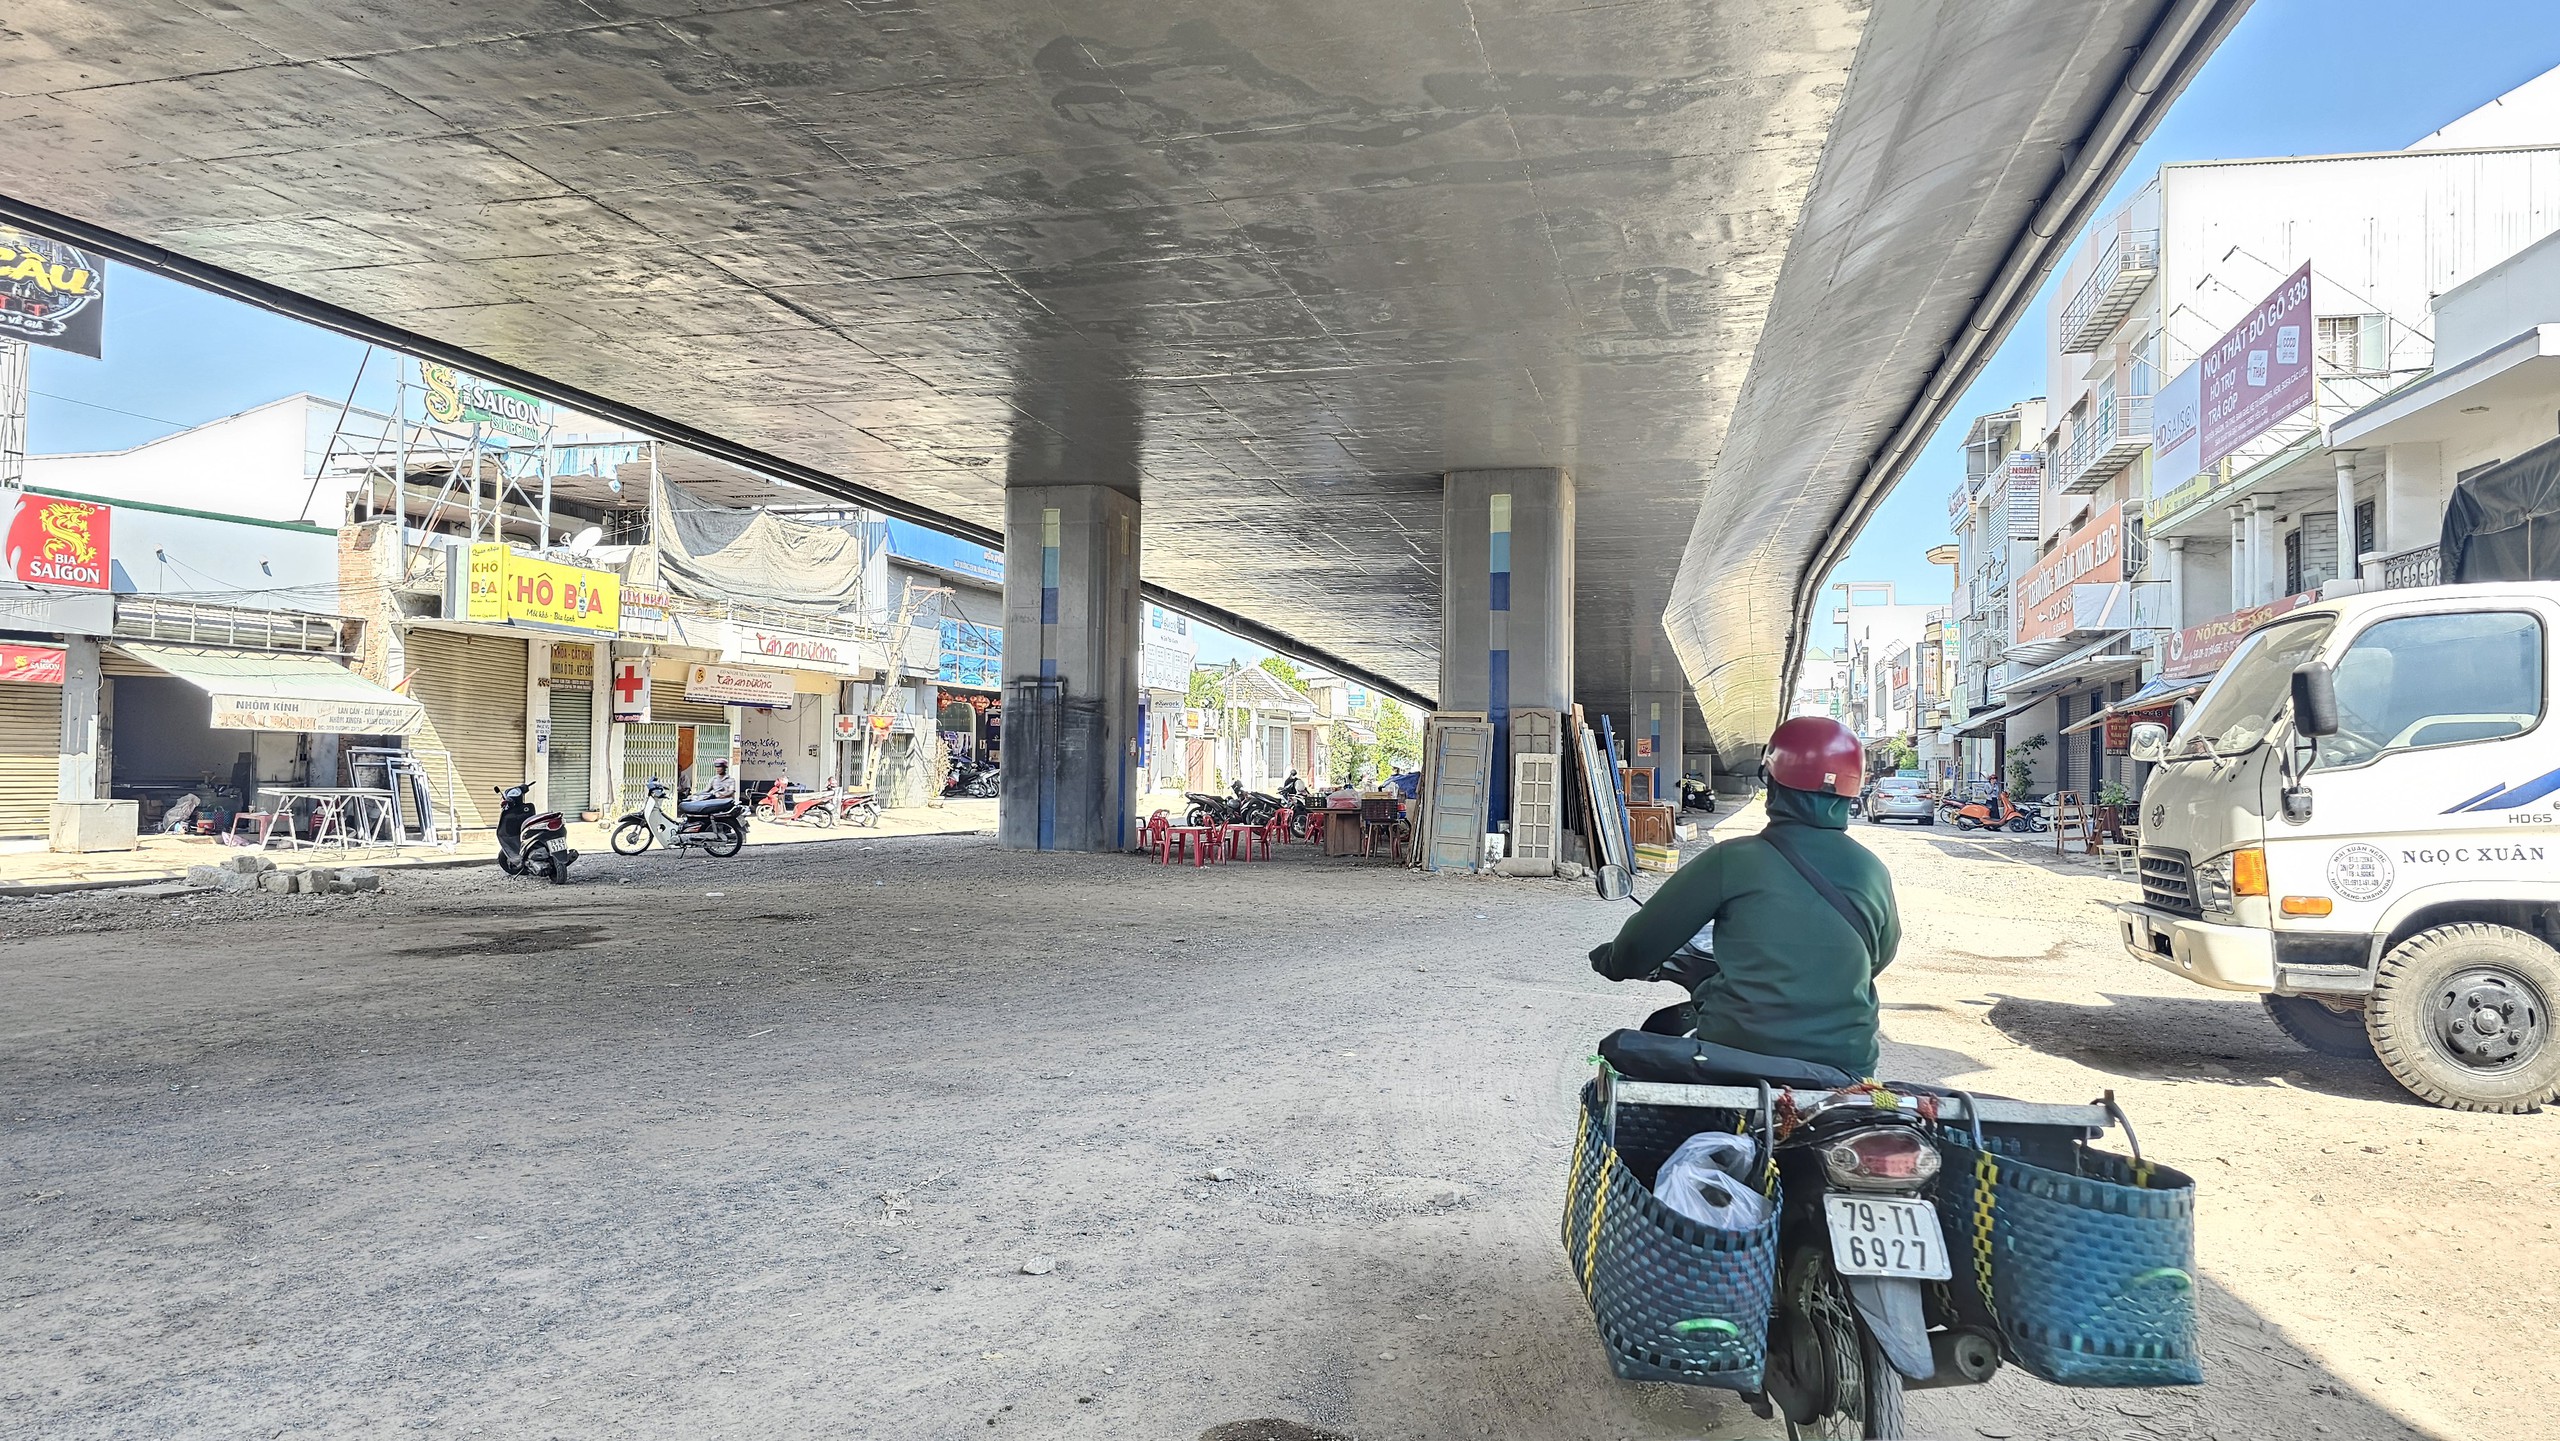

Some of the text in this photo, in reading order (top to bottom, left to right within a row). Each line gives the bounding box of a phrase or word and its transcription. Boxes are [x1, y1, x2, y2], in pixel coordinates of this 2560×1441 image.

[2204, 276, 2307, 380] NỘI THẤT ĐỒ GỖ 338
[2220, 367, 2236, 392] TRỢ
[462, 384, 470, 404] BIA
[473, 386, 541, 426] SAIGON
[2208, 391, 2238, 426] TRẢ GÓP
[55, 554, 76, 564] BIA
[472, 560, 498, 572] KHÔ
[2054, 545, 2075, 592] MẦM
[2075, 539, 2094, 579] NON
[2095, 524, 2118, 568] ABC
[30, 561, 100, 584] SAIGON
[236, 700, 299, 712] NHÔM KÍNH
[2509, 814, 2552, 824] HD65
[2402, 844, 2544, 866] NGỌC XUÂN
[1842, 1201, 1920, 1236] 79-T1
[1850, 1236, 1926, 1271] 6927
